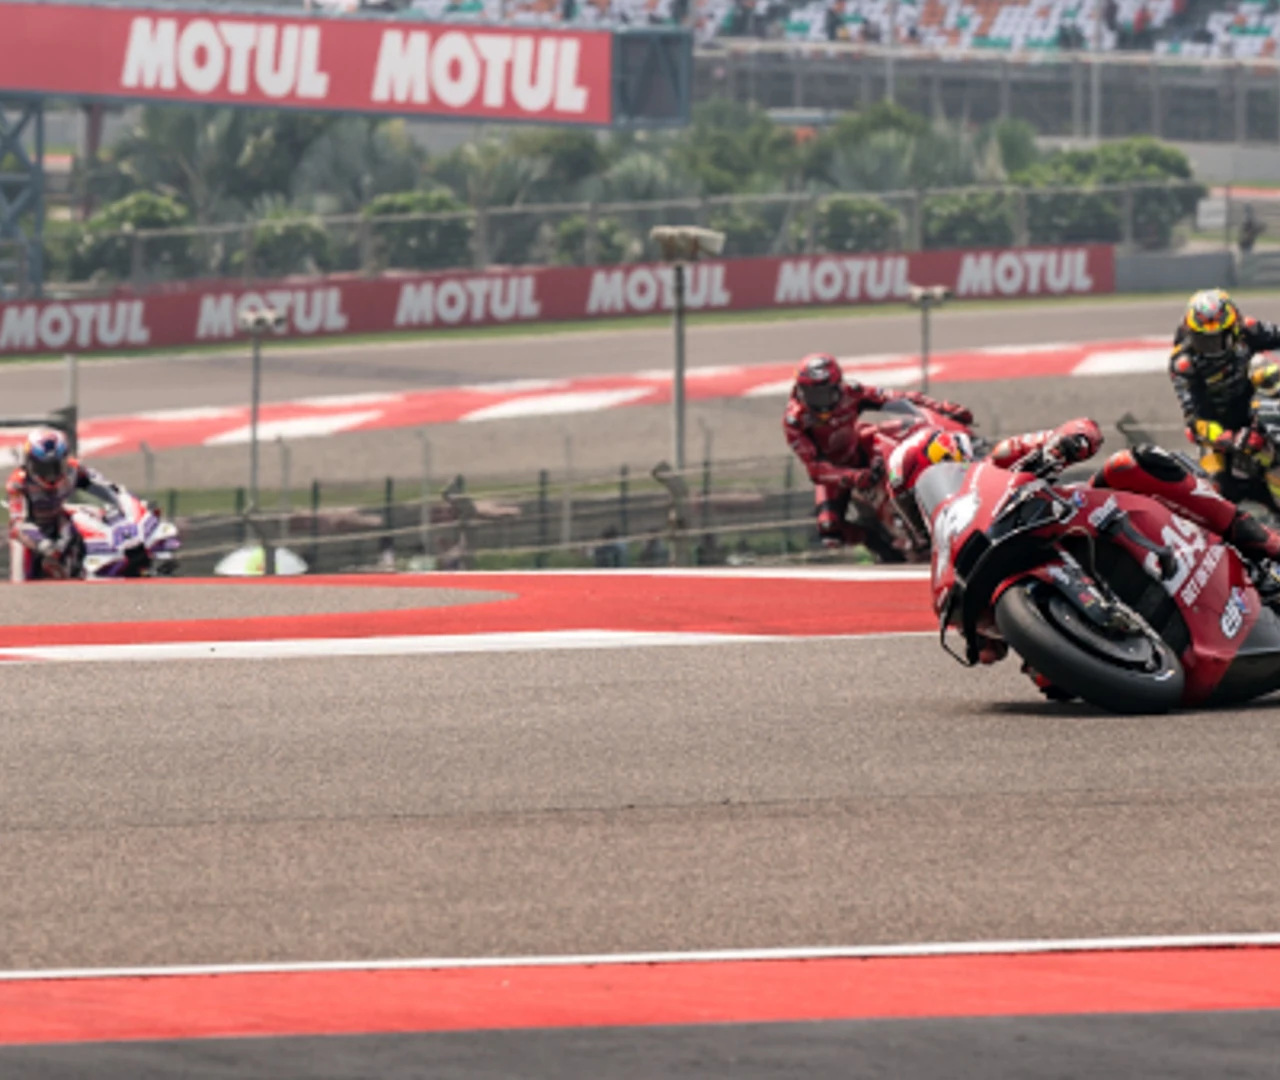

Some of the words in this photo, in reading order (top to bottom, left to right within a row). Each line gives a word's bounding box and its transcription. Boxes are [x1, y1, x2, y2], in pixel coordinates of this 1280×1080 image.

[122, 16, 329, 99] MOTUL
[371, 29, 588, 113] MOTUL
[196, 286, 348, 339] MOTUL
[395, 274, 541, 326] MOTUL
[586, 263, 731, 314] MOTUL
[774, 256, 914, 304] MOTUL
[957, 249, 1093, 295] MOTUL
